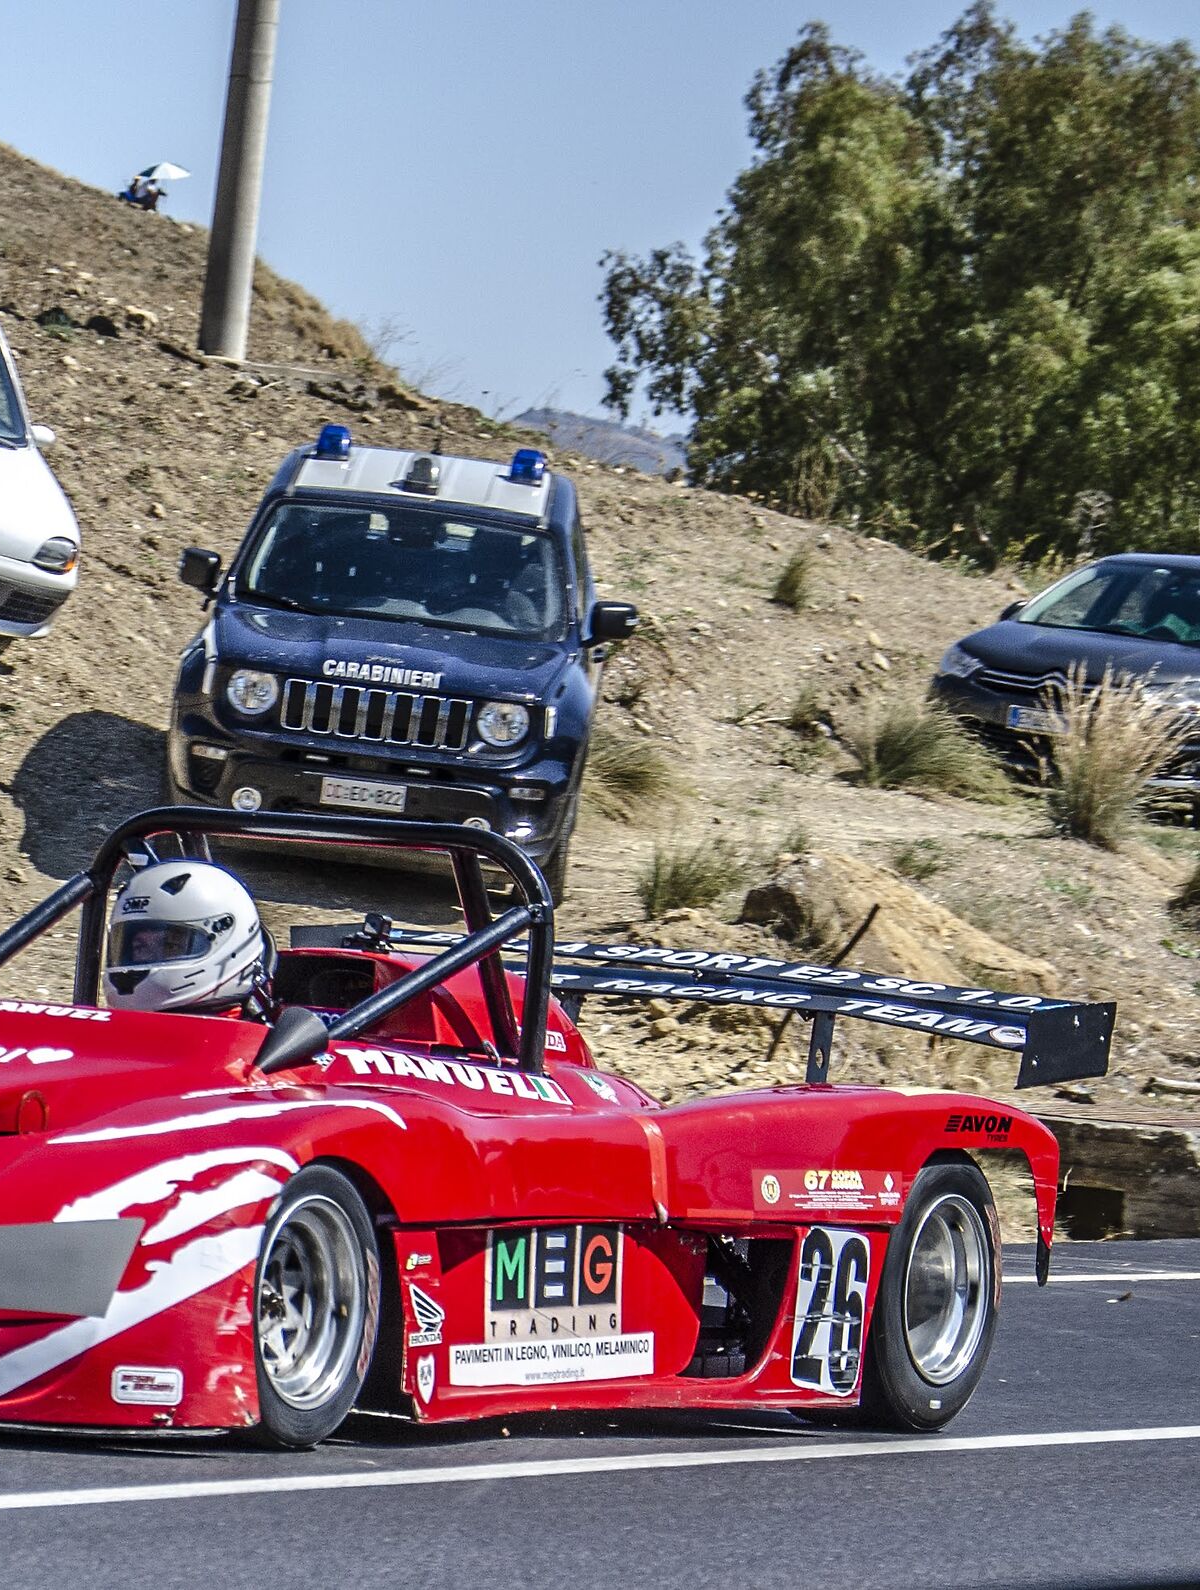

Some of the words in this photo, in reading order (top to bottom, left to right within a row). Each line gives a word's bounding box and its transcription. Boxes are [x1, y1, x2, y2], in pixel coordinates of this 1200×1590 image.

[322, 659, 441, 689] CARABINIERI
[122, 898, 150, 912] OMP
[594, 945, 787, 973] SPORT
[778, 965, 861, 985] E2
[862, 977, 947, 996] SC
[956, 990, 1043, 1008] 1.0
[593, 978, 812, 1004] RACING
[837, 999, 998, 1036] TEAM
[334, 1047, 547, 1100] MANUEL
[959, 1114, 1014, 1133] AVON
[803, 1170, 832, 1191] 67
[495, 1233, 614, 1301] MEG
[792, 1227, 869, 1393] 26
[410, 1332, 442, 1345] HONDA
[489, 1312, 618, 1338] TRADING
[455, 1347, 503, 1364] PAVIMENTI
[504, 1347, 514, 1360] IN
[516, 1345, 550, 1362] LEGNO,
[551, 1342, 594, 1359] VINILICO,
[595, 1339, 650, 1356] MELAMINICO
